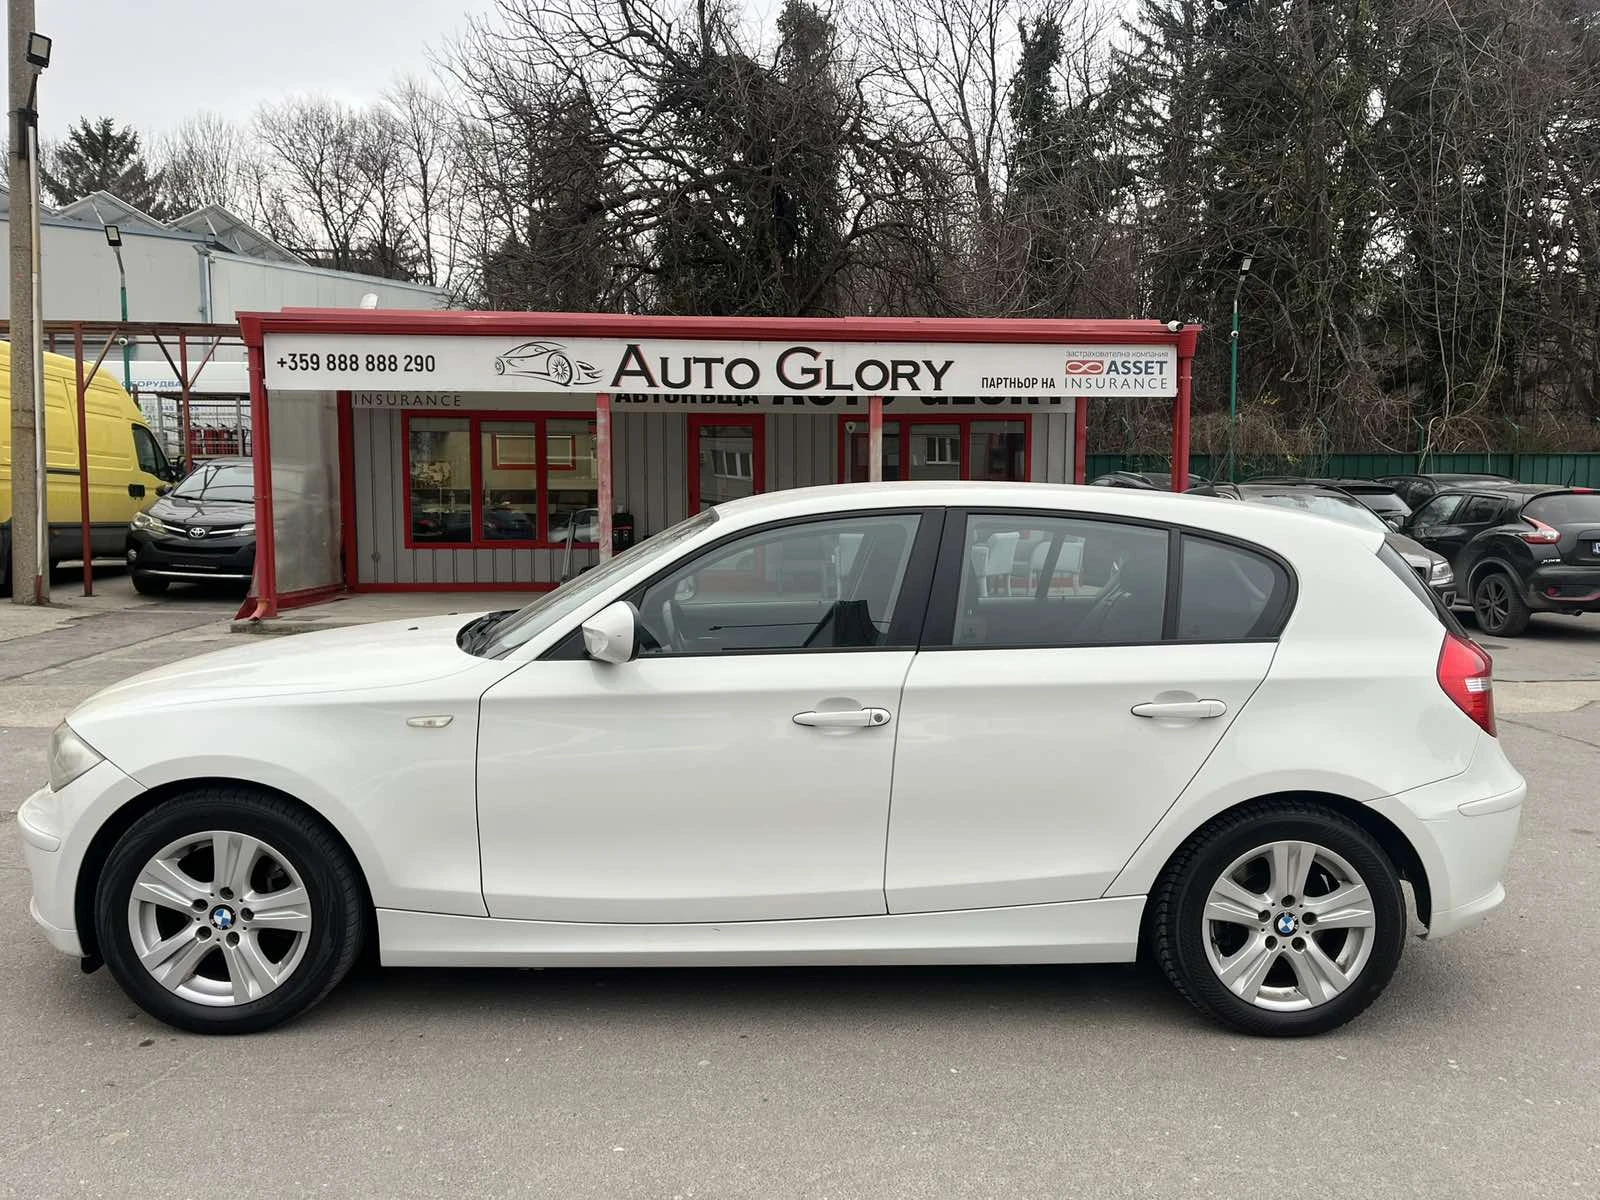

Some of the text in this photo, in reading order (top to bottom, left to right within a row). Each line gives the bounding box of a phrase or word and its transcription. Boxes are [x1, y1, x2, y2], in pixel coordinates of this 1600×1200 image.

[277, 353, 436, 372] +359 888 888 290
[610, 344, 954, 391] AUTO GLORY
[1106, 360, 1168, 375] ASSET
[981, 377, 1056, 389] ПАРТНЬОР НА
[1065, 377, 1168, 389] INSURANCE
[354, 393, 462, 407] INSURANCE
